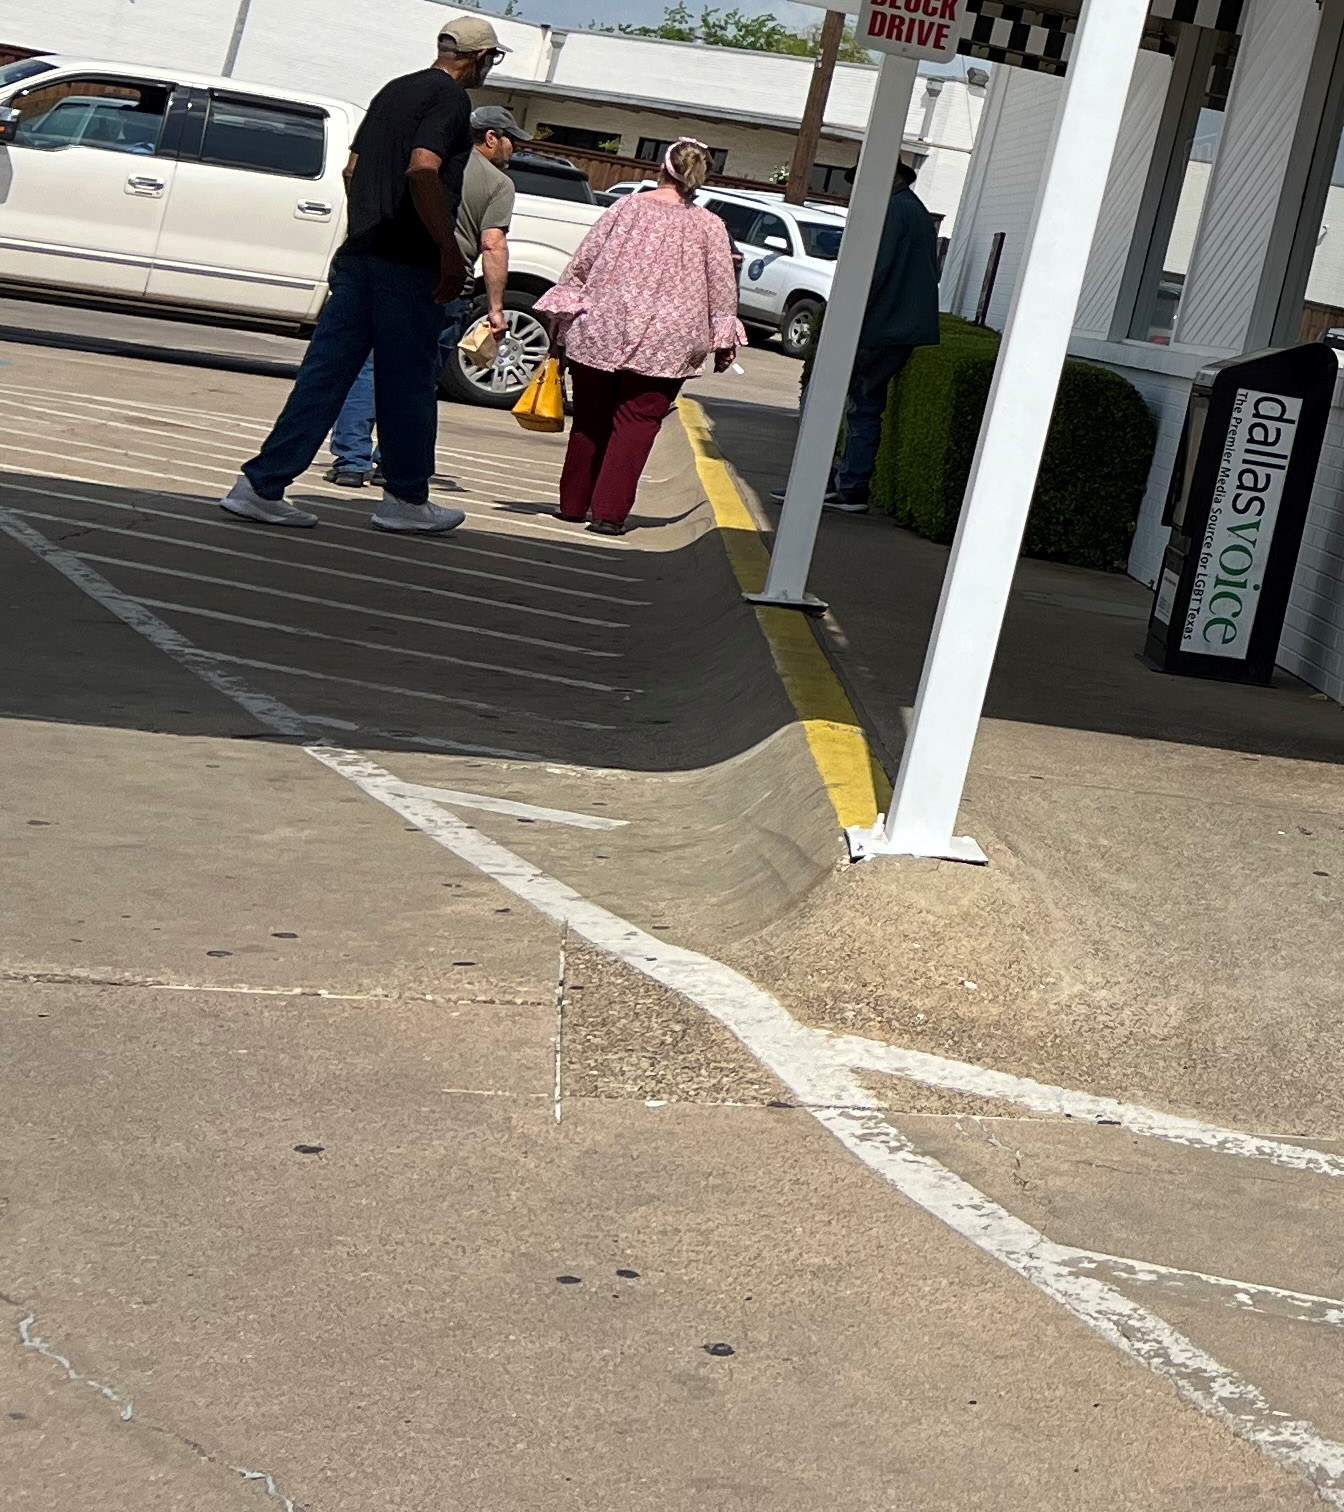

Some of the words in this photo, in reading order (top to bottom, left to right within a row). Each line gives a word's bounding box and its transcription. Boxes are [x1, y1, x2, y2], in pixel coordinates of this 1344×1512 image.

[867, 10, 951, 51] DRIVE
[1234, 391, 1249, 414] The
[1223, 416, 1243, 465] Premier
[1213, 466, 1232, 504] Media
[1203, 507, 1222, 549] Source
[1199, 551, 1213, 570] for
[1191, 572, 1209, 605] LGBT
[1183, 606, 1201, 640] Texas
